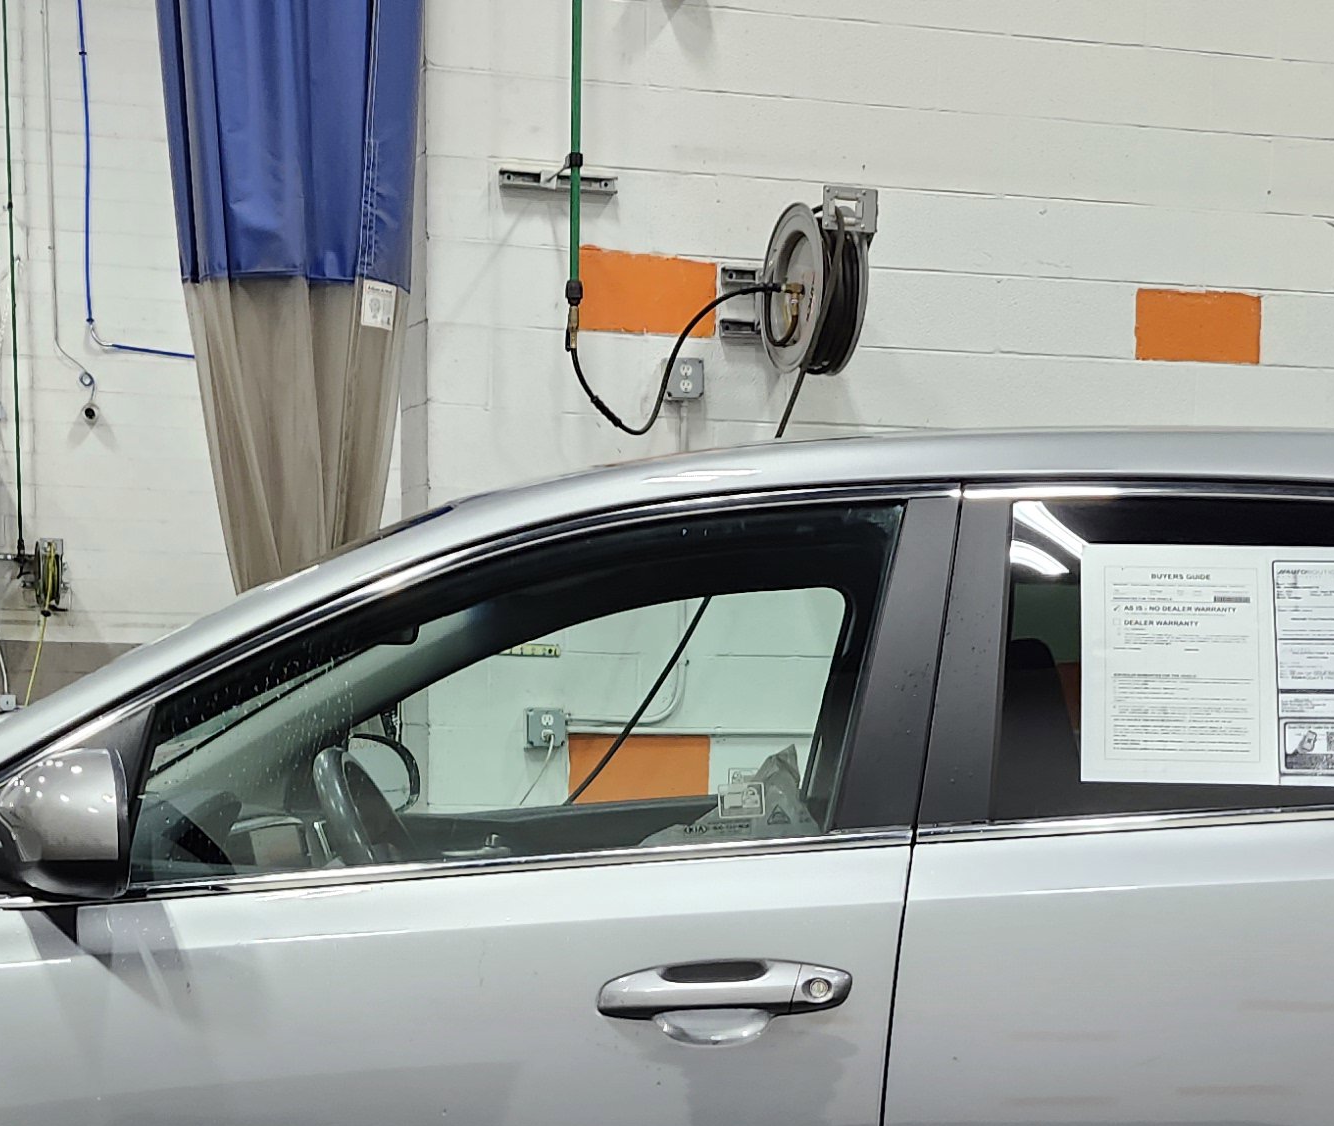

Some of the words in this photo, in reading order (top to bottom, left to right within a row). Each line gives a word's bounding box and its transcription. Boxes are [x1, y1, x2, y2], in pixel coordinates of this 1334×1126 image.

[1123, 604, 1134, 612] AS
[1136, 604, 1143, 612] IS
[1162, 605, 1192, 613] DEALER
[1123, 619, 1154, 627] DEALER
